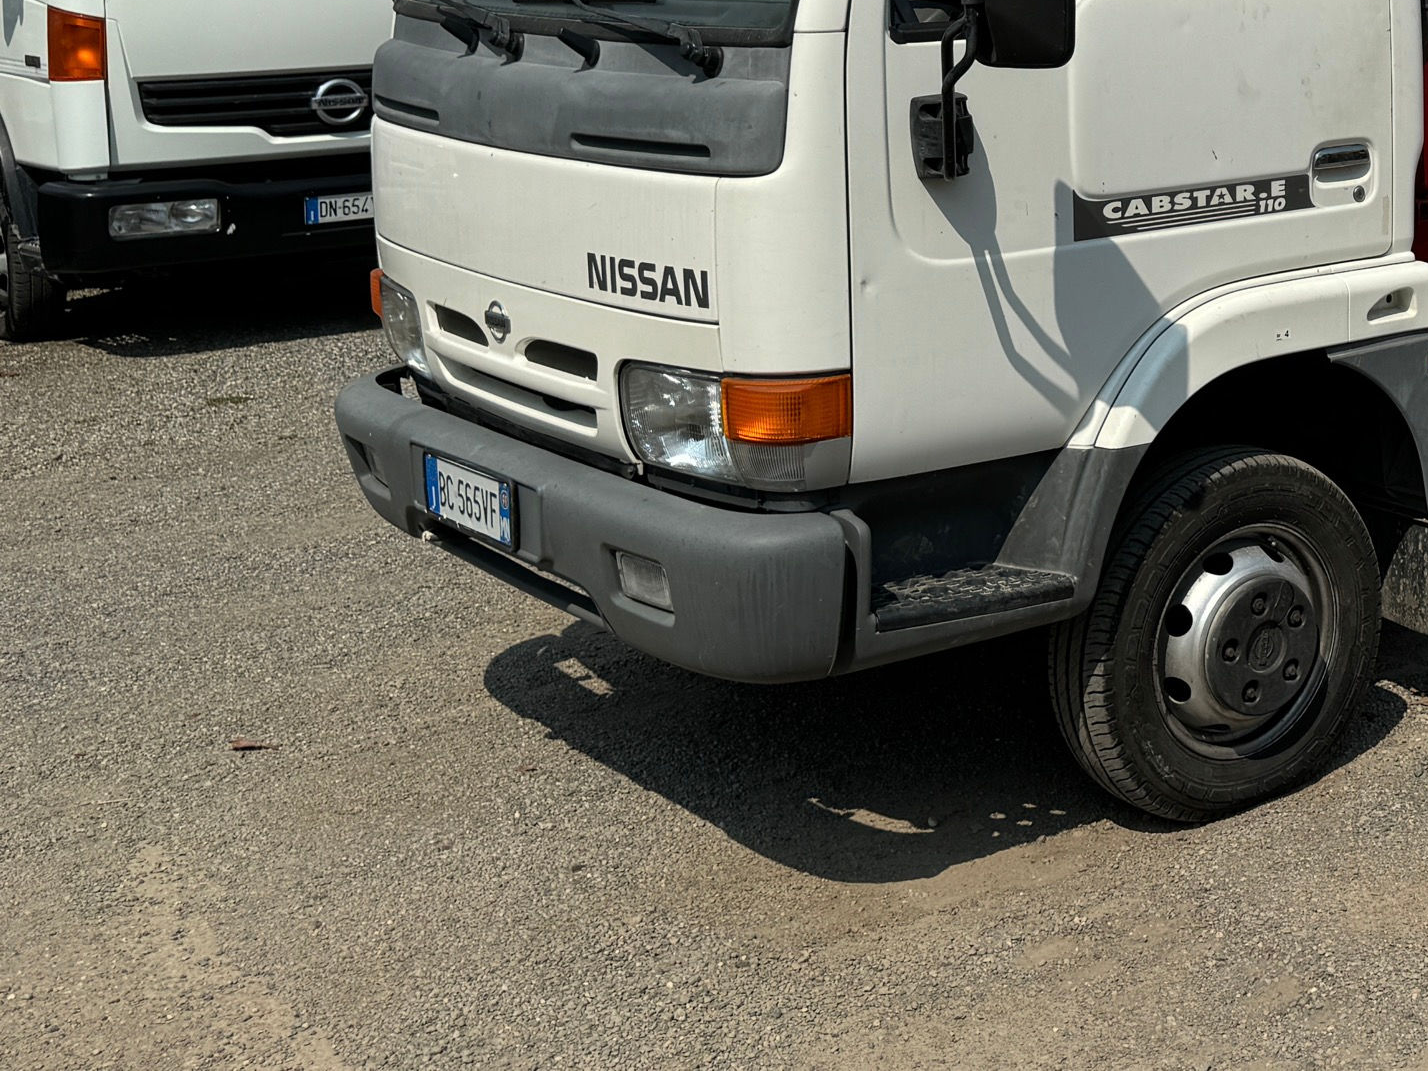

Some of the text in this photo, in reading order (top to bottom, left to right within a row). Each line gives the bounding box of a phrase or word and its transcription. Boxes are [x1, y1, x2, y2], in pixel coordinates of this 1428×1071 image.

[1259, 197, 1287, 214] 110
[586, 252, 710, 310] NISSAN
[438, 470, 455, 511] BC
